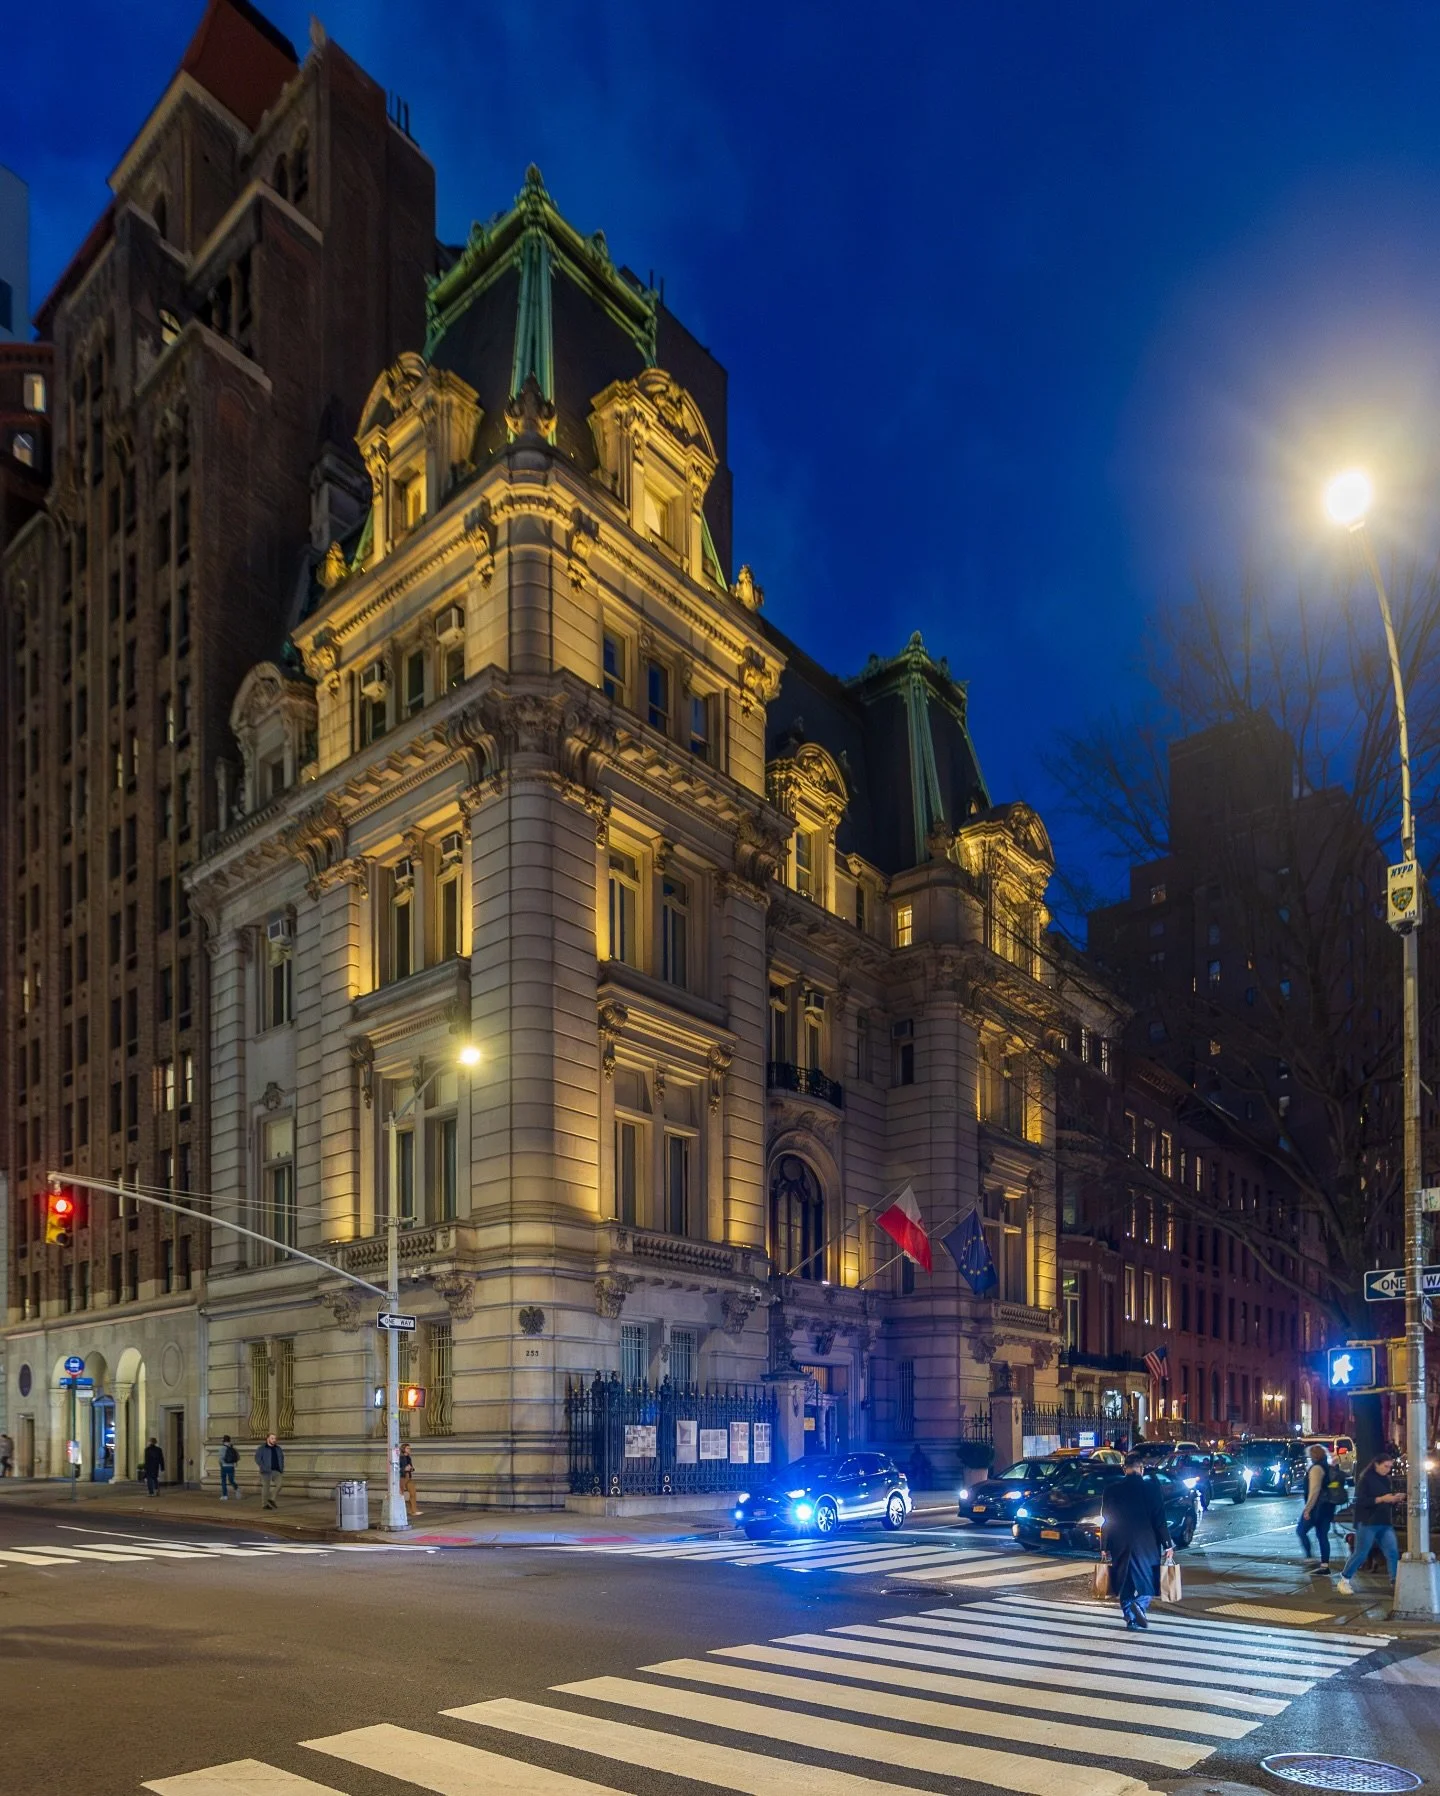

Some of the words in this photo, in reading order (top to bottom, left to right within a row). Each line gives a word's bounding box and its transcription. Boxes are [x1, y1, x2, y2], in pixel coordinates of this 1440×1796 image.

[1391, 864, 1413, 877] NYPD
[1381, 1278, 1406, 1290] ONE
[1426, 1275, 1440, 1286] WA
